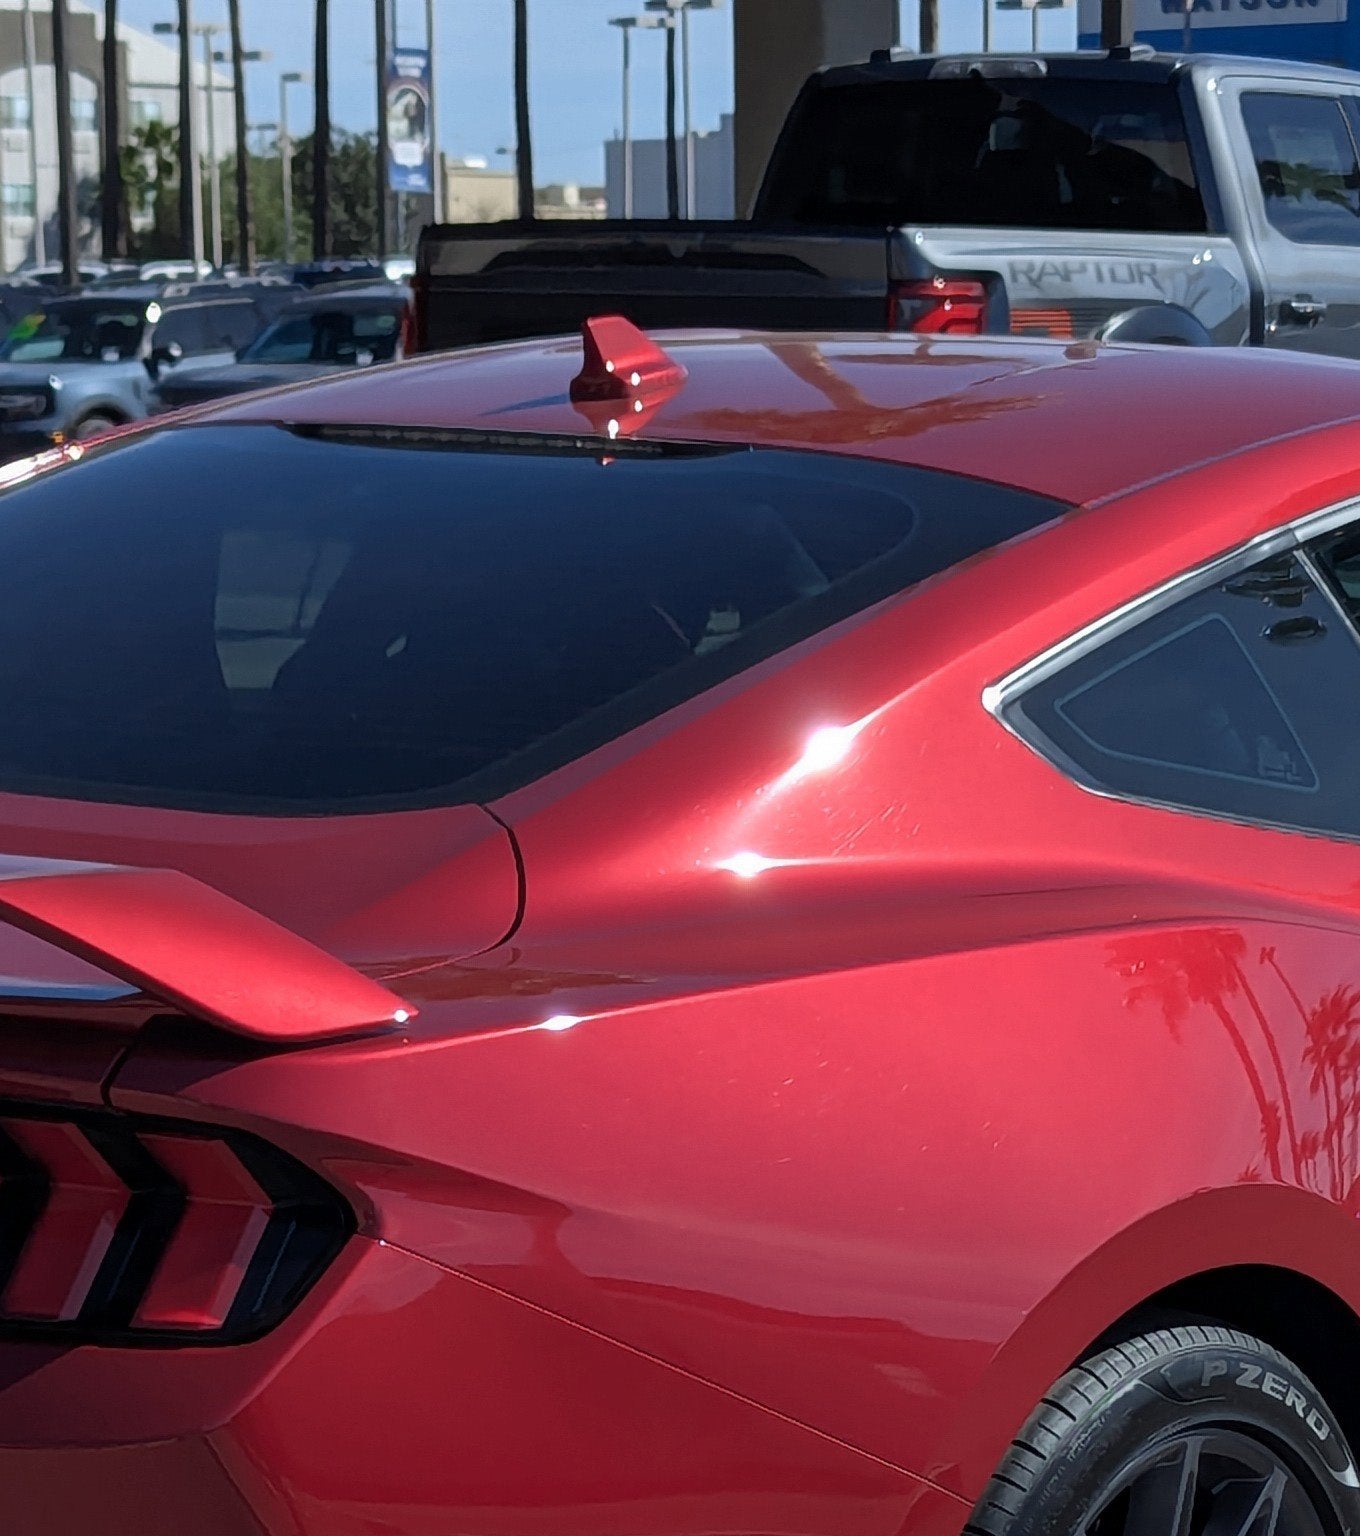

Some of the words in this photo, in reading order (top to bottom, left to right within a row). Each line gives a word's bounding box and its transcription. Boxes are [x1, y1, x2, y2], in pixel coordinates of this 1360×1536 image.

[1007, 260, 1166, 292] RAPTOR
[1201, 1360, 1228, 1387] P
[1235, 1361, 1331, 1441] ZERO
